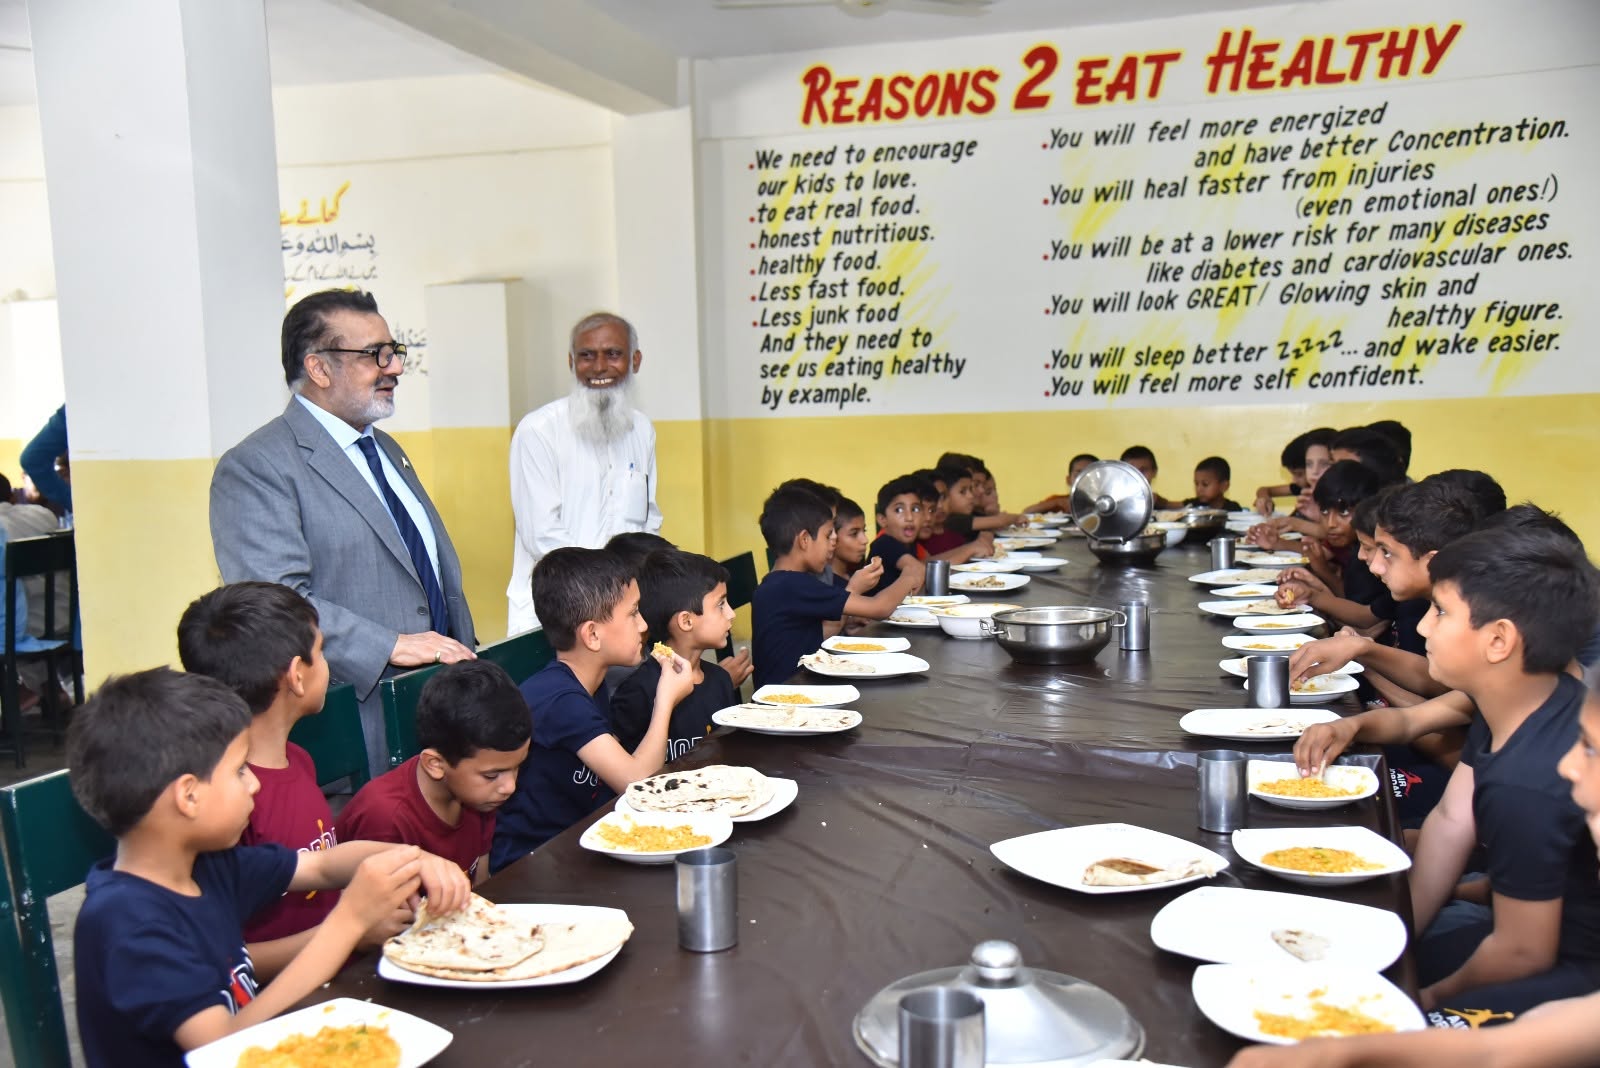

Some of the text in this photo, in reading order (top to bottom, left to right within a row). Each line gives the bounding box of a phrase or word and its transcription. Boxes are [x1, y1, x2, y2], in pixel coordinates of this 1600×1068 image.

[801, 23, 1462, 126] REASONS 2 EAT HEALTHY
[1050, 101, 1389, 149] You will feel more energized
[755, 140, 978, 170] We need to encourage
[1194, 116, 1569, 168] and have better Concentration.
[757, 169, 916, 197] our kids to love.
[1050, 161, 1436, 205] You will heal faster from injuries
[1296, 173, 1558, 218] (even emotional ones!)
[757, 194, 920, 224] to eat real food.
[758, 223, 934, 249] honest nutritious.
[1051, 212, 1550, 261] You will be at a lower risk for many diseases
[758, 250, 881, 279] healthy food.
[1146, 241, 1572, 283] like diabetes and cardiovascular ones.
[758, 275, 905, 302] Less fast food.
[1051, 294, 1084, 315] You
[1092, 291, 1131, 313] will
[1136, 289, 1179, 311] look
[1279, 279, 1371, 307] Glowing
[1380, 276, 1427, 300] skin
[1437, 272, 1480, 297] and
[759, 302, 901, 333] Less junk food
[1387, 300, 1563, 330] healthy figure.
[760, 327, 933, 356] And they need to
[1051, 349, 1083, 370] You
[1089, 347, 1126, 369] will
[1134, 345, 1185, 371] sleep
[1192, 341, 1268, 365] better
[1363, 335, 1407, 358] and
[1416, 332, 1479, 356] wake
[1487, 328, 1560, 354] easier.
[759, 352, 967, 381] see us eating healthy
[1051, 363, 1424, 397] You will feel more self confident.
[761, 382, 871, 411] by example.
[1397, 773, 1407, 787] AIR
